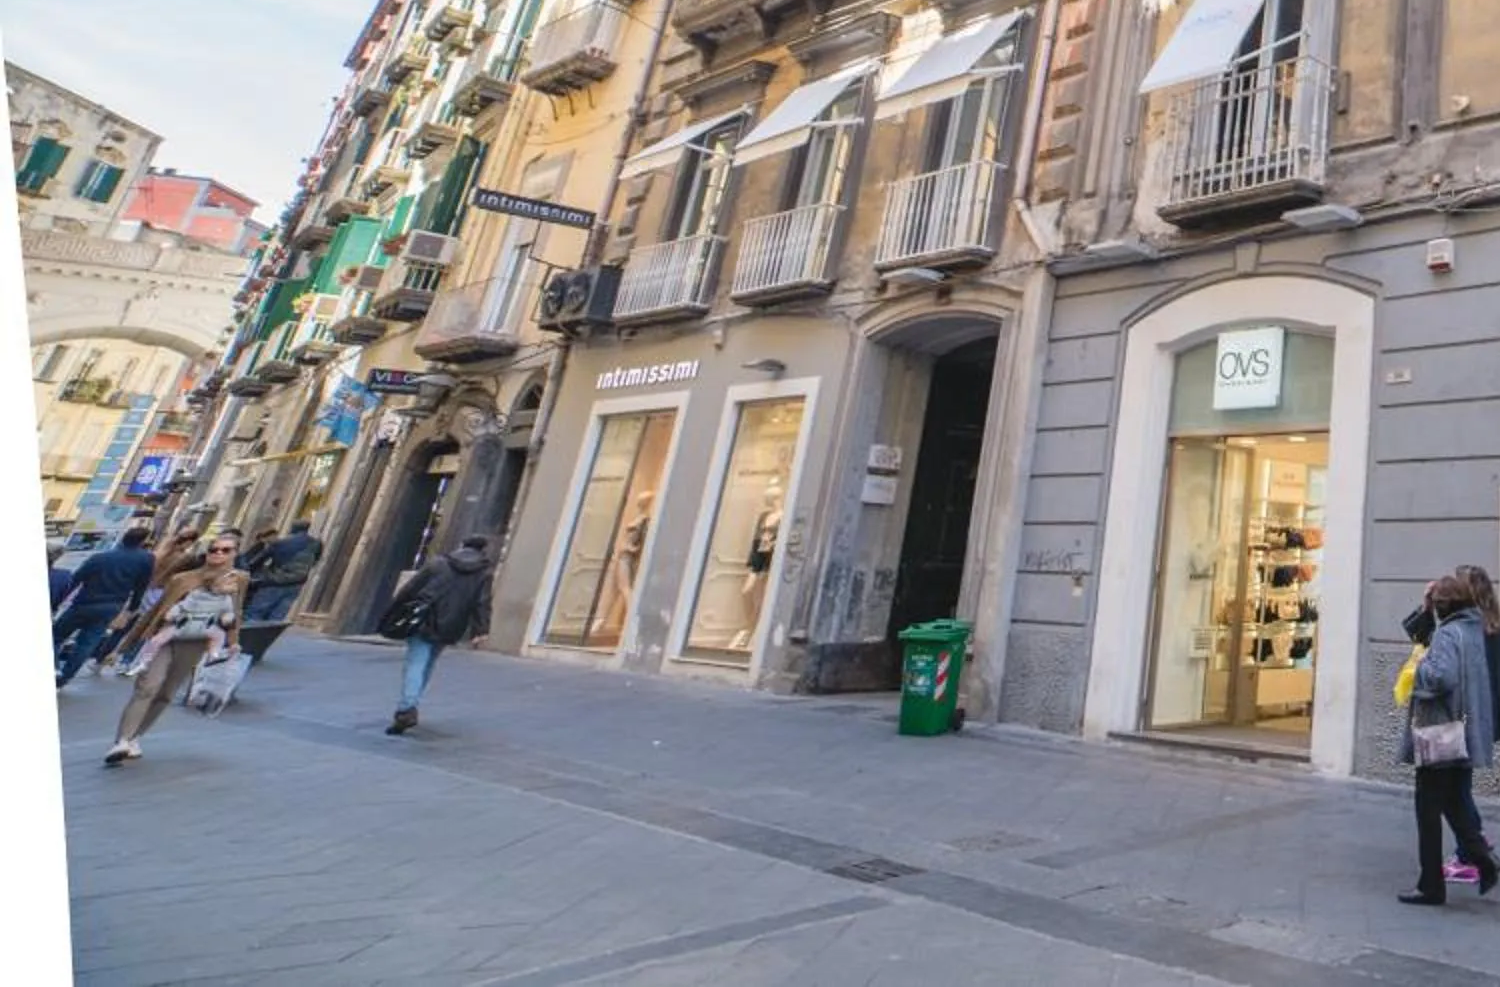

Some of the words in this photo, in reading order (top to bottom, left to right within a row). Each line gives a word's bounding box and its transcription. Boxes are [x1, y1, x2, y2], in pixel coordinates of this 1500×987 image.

[479, 193, 591, 224] intimissimi
[595, 359, 699, 389] intimissimi
[1219, 348, 1269, 380] OVS
